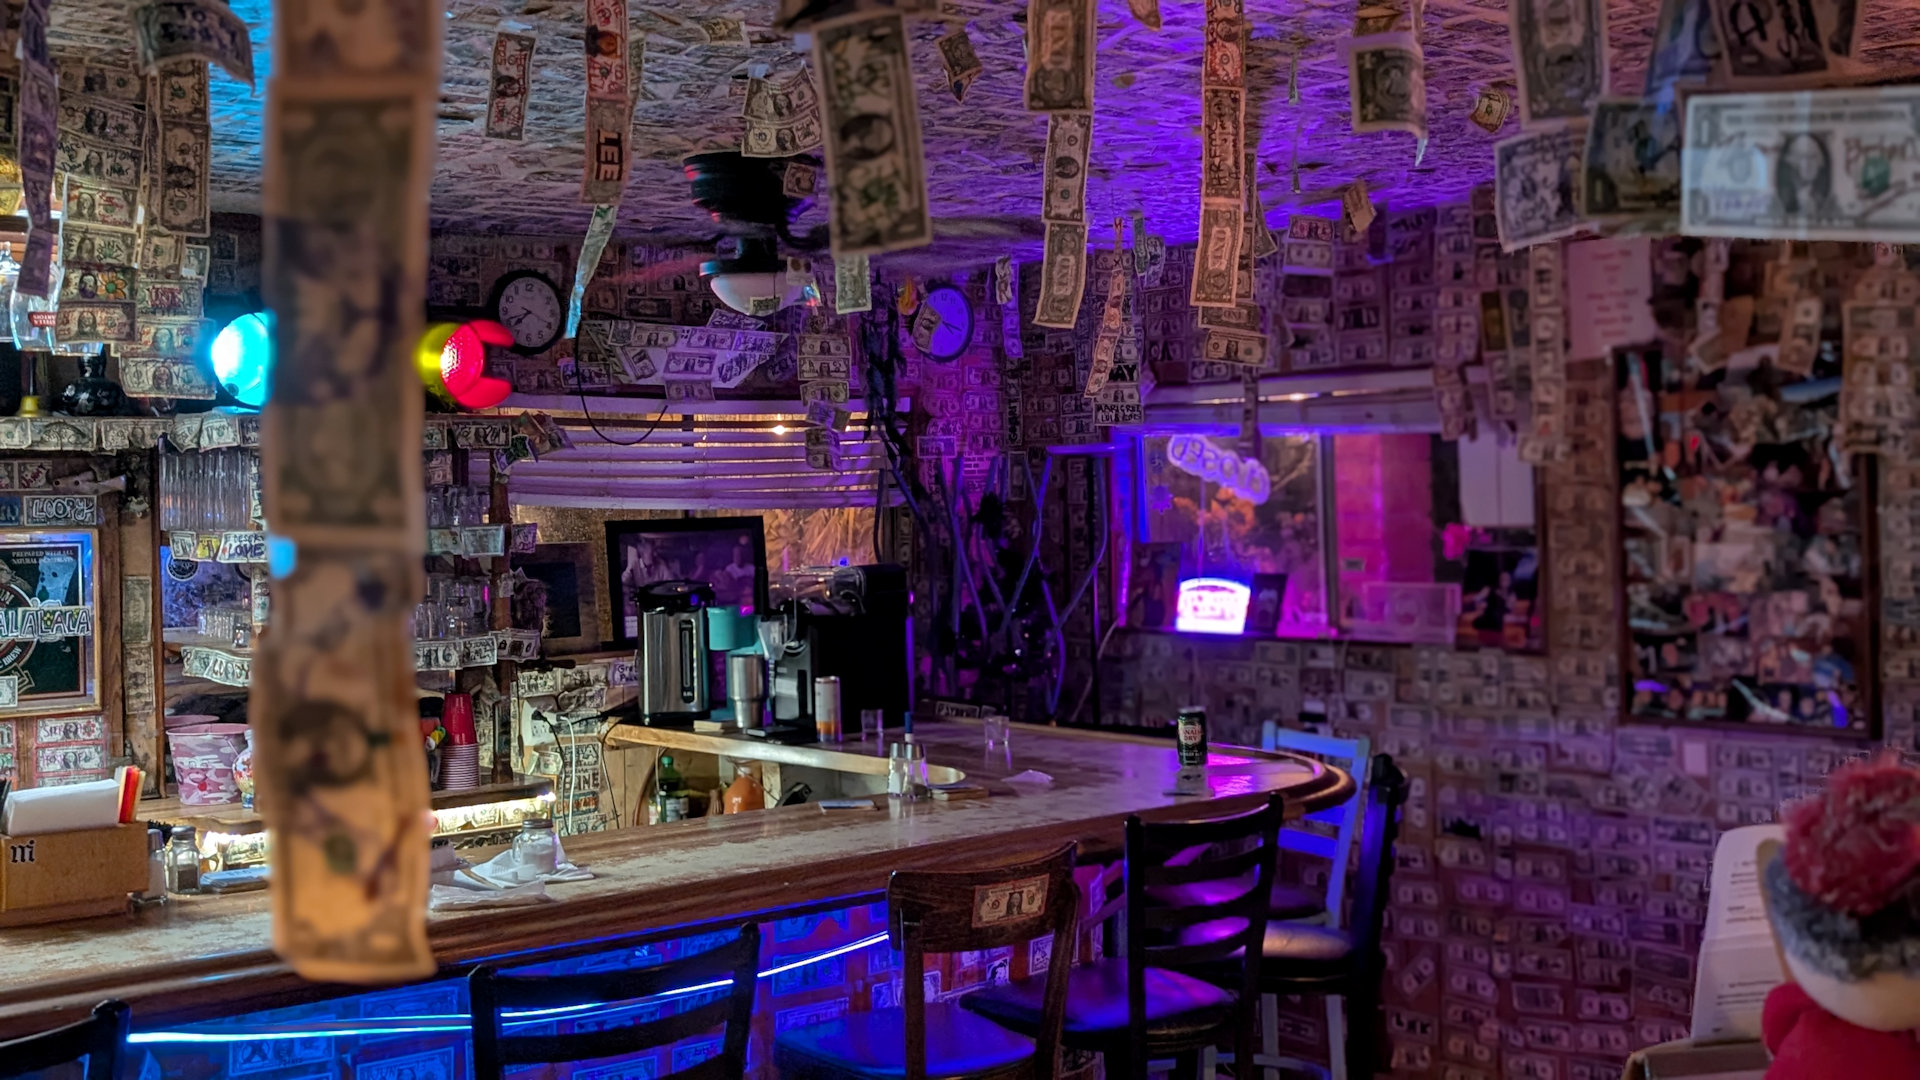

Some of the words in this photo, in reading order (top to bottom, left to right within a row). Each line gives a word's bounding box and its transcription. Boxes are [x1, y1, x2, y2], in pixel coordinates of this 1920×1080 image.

[526, 284, 534, 292] 12
[505, 295, 514, 304] 10
[526, 333, 532, 342] 6
[537, 330, 544, 339] 5
[228, 543, 265, 557] LOVE
[2, 645, 22, 666] BREW
